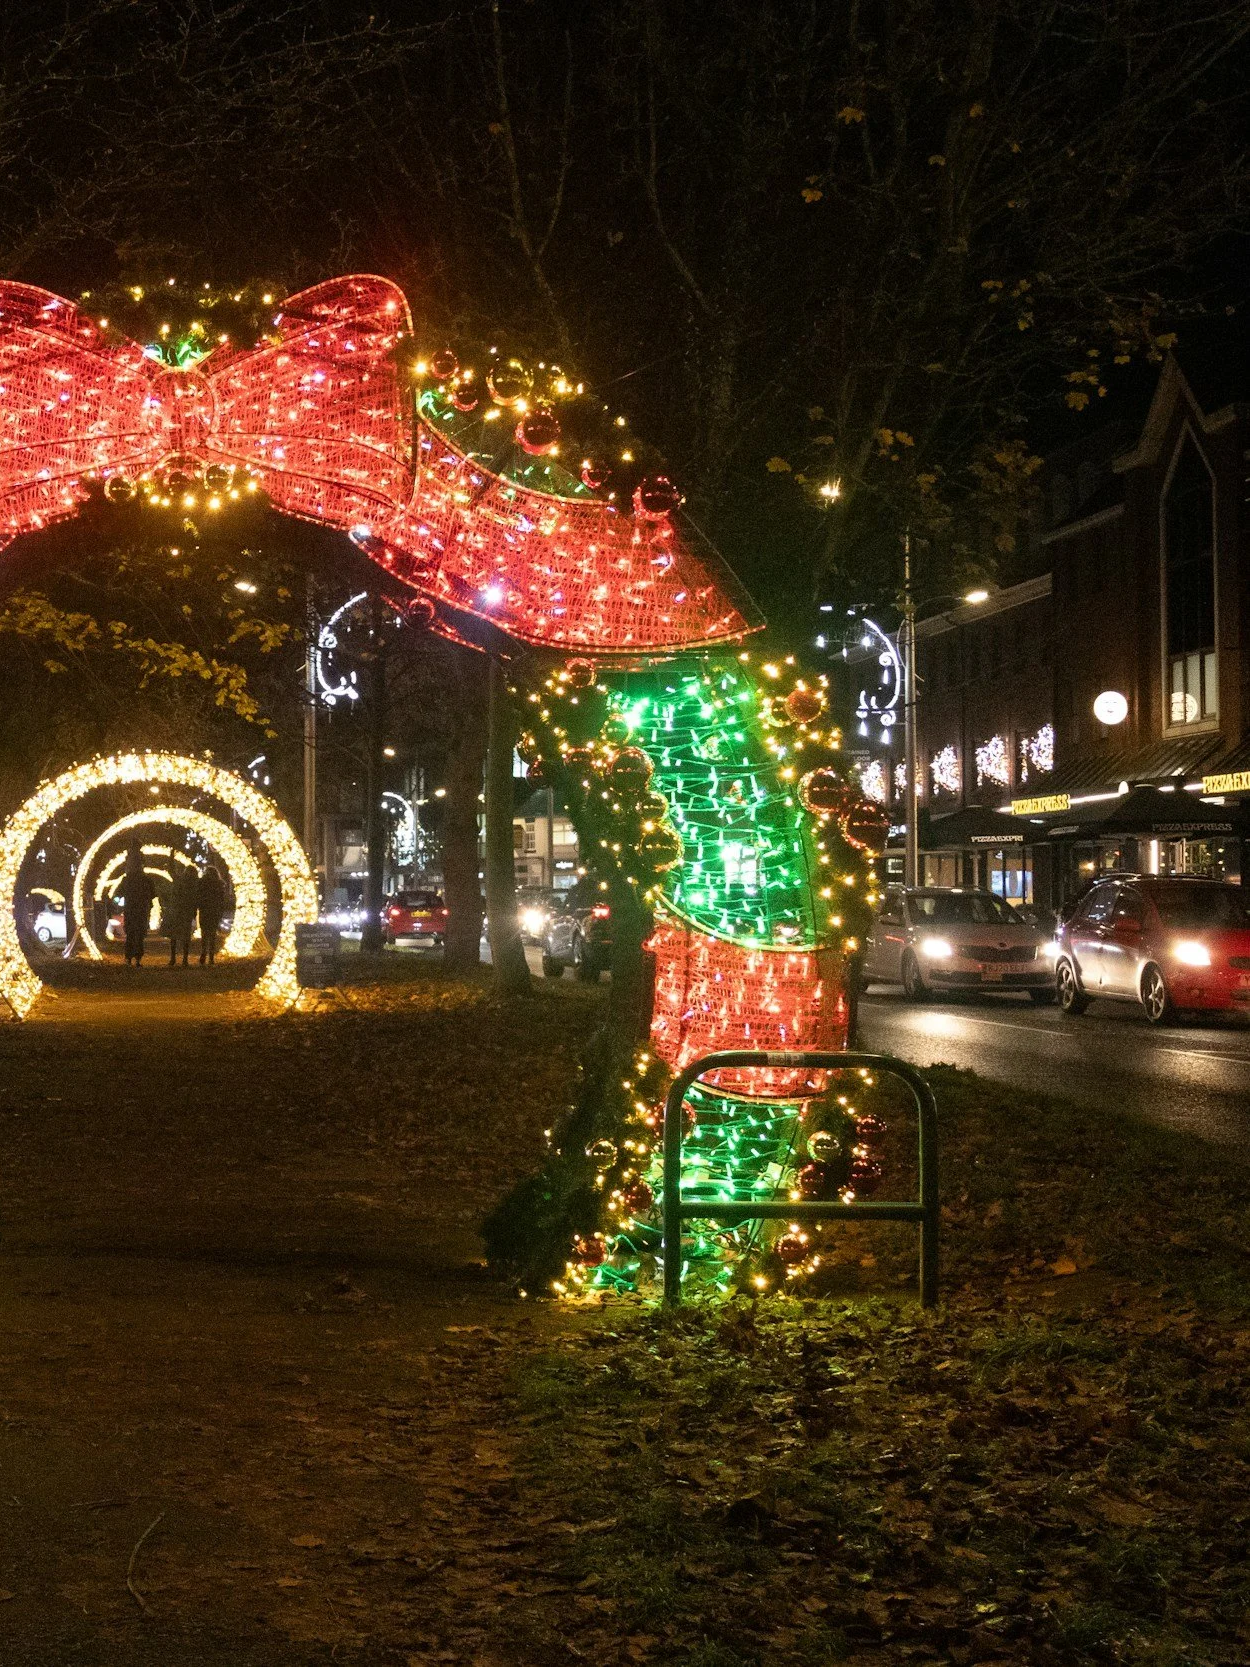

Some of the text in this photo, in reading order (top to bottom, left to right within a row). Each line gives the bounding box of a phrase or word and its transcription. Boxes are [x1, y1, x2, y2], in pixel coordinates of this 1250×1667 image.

[1202, 770, 1250, 794] PIZZAEX
[1011, 794, 1068, 815] PIZZAEXPRESS
[1152, 822, 1233, 832] PIZZAEXPRESS
